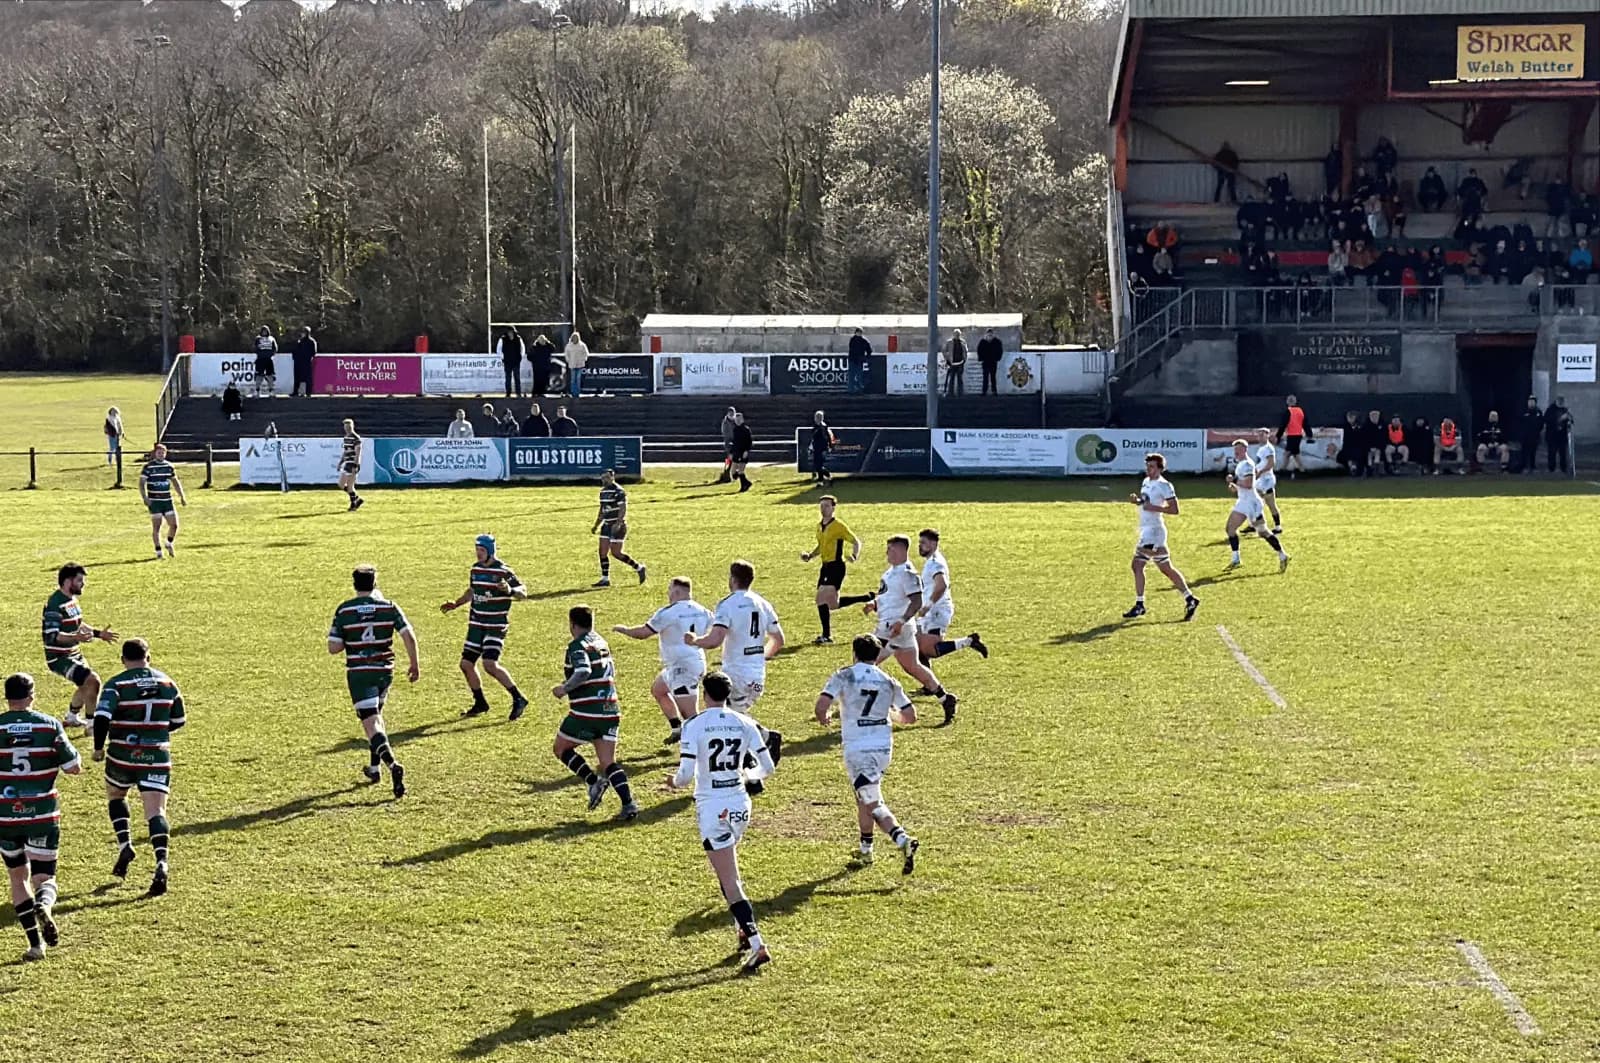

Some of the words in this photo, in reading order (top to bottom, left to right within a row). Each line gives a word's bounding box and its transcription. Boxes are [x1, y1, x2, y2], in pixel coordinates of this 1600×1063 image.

[1467, 60, 1514, 73] Welsh
[1521, 61, 1574, 73] Butter
[1354, 346, 1391, 355] HOME
[221, 357, 257, 375] pain
[337, 360, 365, 370] Peter
[368, 359, 397, 373] Lynn
[787, 358, 869, 371] ABSOLUE
[1561, 355, 1593, 364] TOILET
[346, 372, 397, 380] PARTNERS
[799, 372, 849, 383] SNOOKE
[1122, 439, 1158, 449] Davies
[1161, 439, 1198, 449] Homes
[420, 453, 488, 464] MORGAN
[750, 611, 760, 639] 4
[361, 623, 376, 642] 4
[860, 689, 879, 717] 7
[708, 738, 742, 772] 23
[11, 748, 32, 776] 5
[729, 811, 749, 824] FSG
